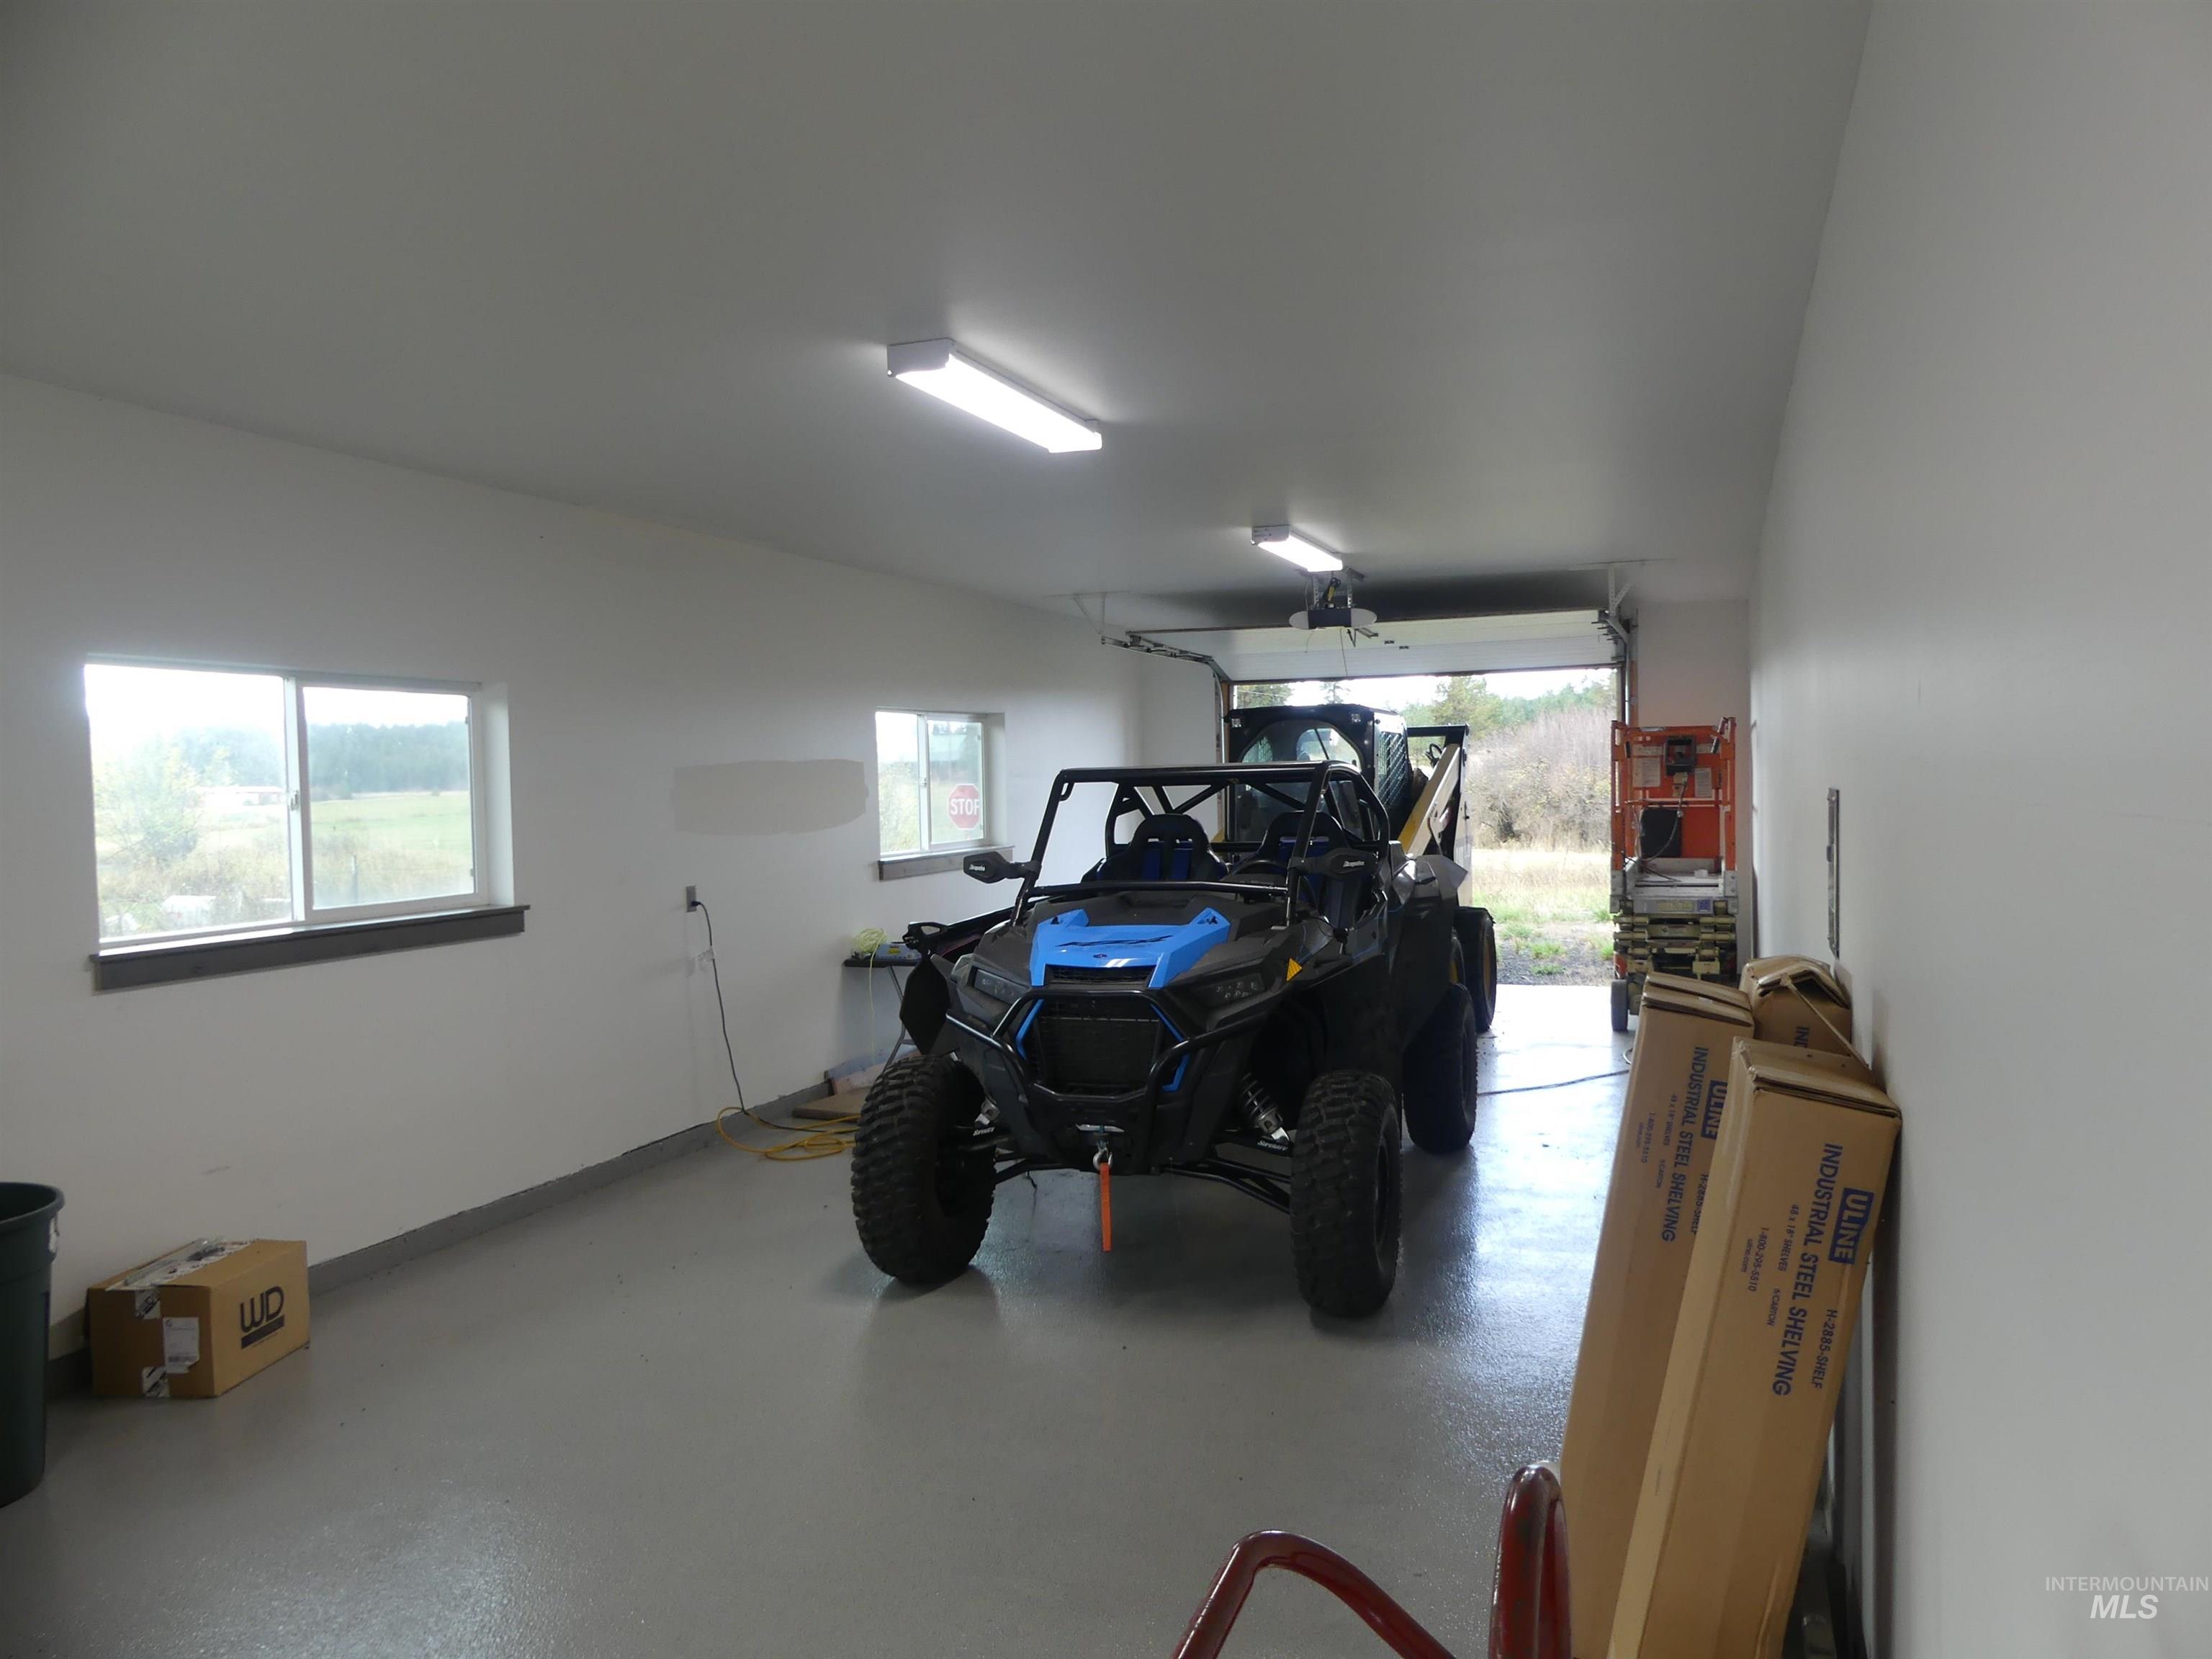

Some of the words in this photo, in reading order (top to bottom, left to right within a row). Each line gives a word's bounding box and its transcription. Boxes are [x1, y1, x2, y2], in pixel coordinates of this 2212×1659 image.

[1681, 1046, 1709, 1126] INDUSTRIAL
[1704, 1083, 1727, 1138] ULINE
[1673, 1130, 1694, 1168] STEEL
[1662, 1173, 1686, 1242] SHELVING
[1790, 1204, 1799, 1215] 48
[1803, 1142, 1843, 1246] INDUSTRIAL
[1833, 1192, 1870, 1261] ULINE
[1748, 1227, 1770, 1292] 1-800-295-5510
[1778, 1238, 1792, 1272] SHELVES
[1791, 1252, 1819, 1300] STEEL
[240, 1286, 284, 1333] WD
[1772, 1306, 1807, 1396] SHELVING
[1811, 1309, 1838, 1389] H-2885-SHELF
